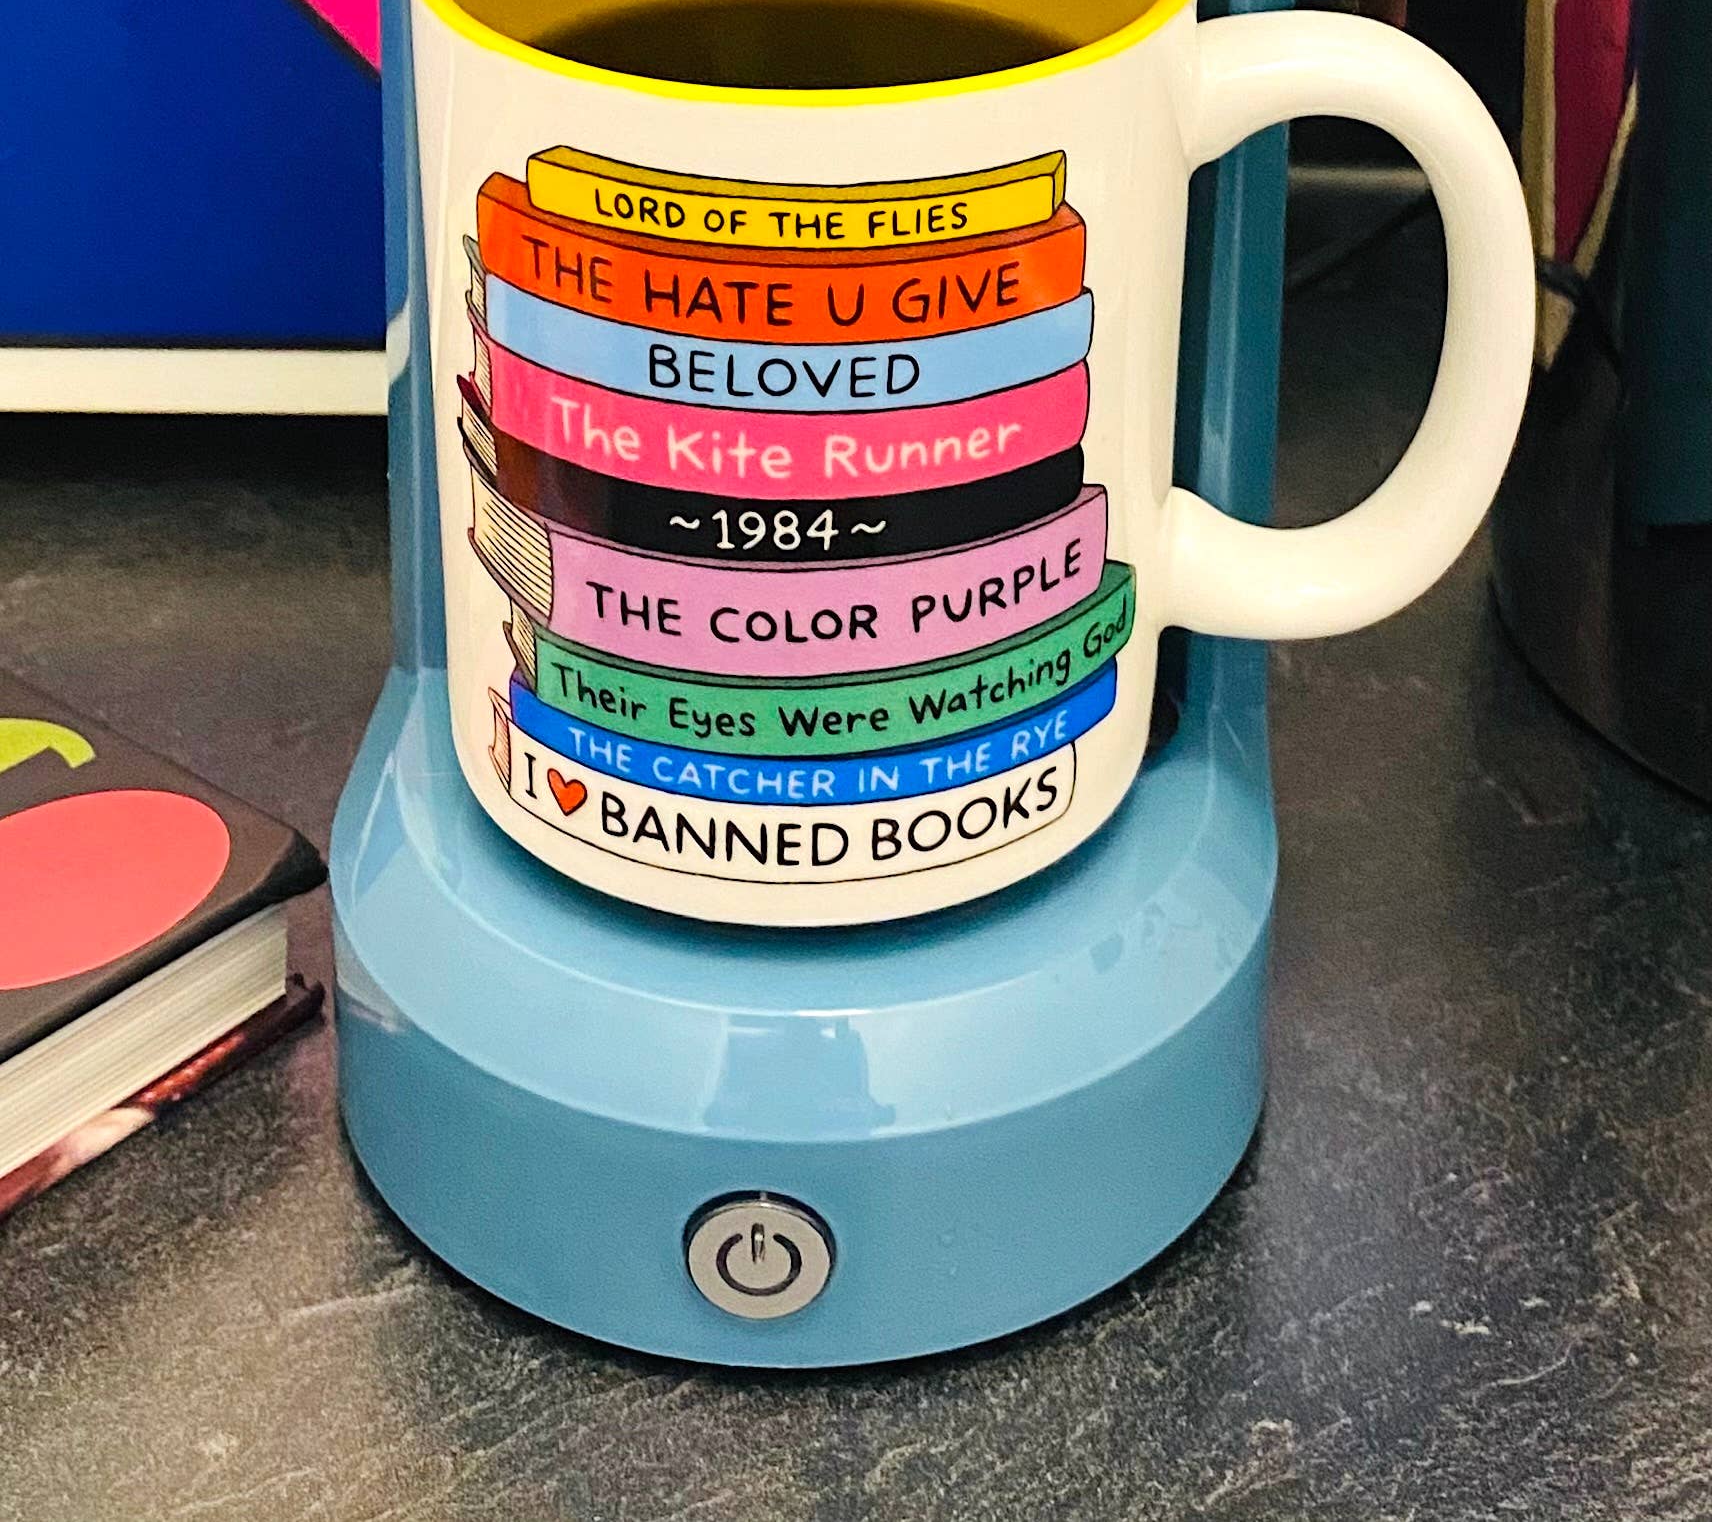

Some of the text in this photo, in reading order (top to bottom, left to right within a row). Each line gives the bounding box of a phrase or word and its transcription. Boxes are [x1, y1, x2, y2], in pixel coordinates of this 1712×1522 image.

[594, 188, 968, 240] LORD OF THE FLIES
[522, 235, 1020, 327] THE HATE U GIVE
[648, 343, 920, 399] BELOVED
[543, 395, 1022, 479] The Kite Runner
[585, 537, 1081, 644] THE COLOR PURPLE
[550, 593, 1126, 740] Their Eyes Were Watching God
[570, 706, 1066, 799] THE CATCHER IN THE RYE
[523, 751, 1058, 867] I BANNED BOOKS
